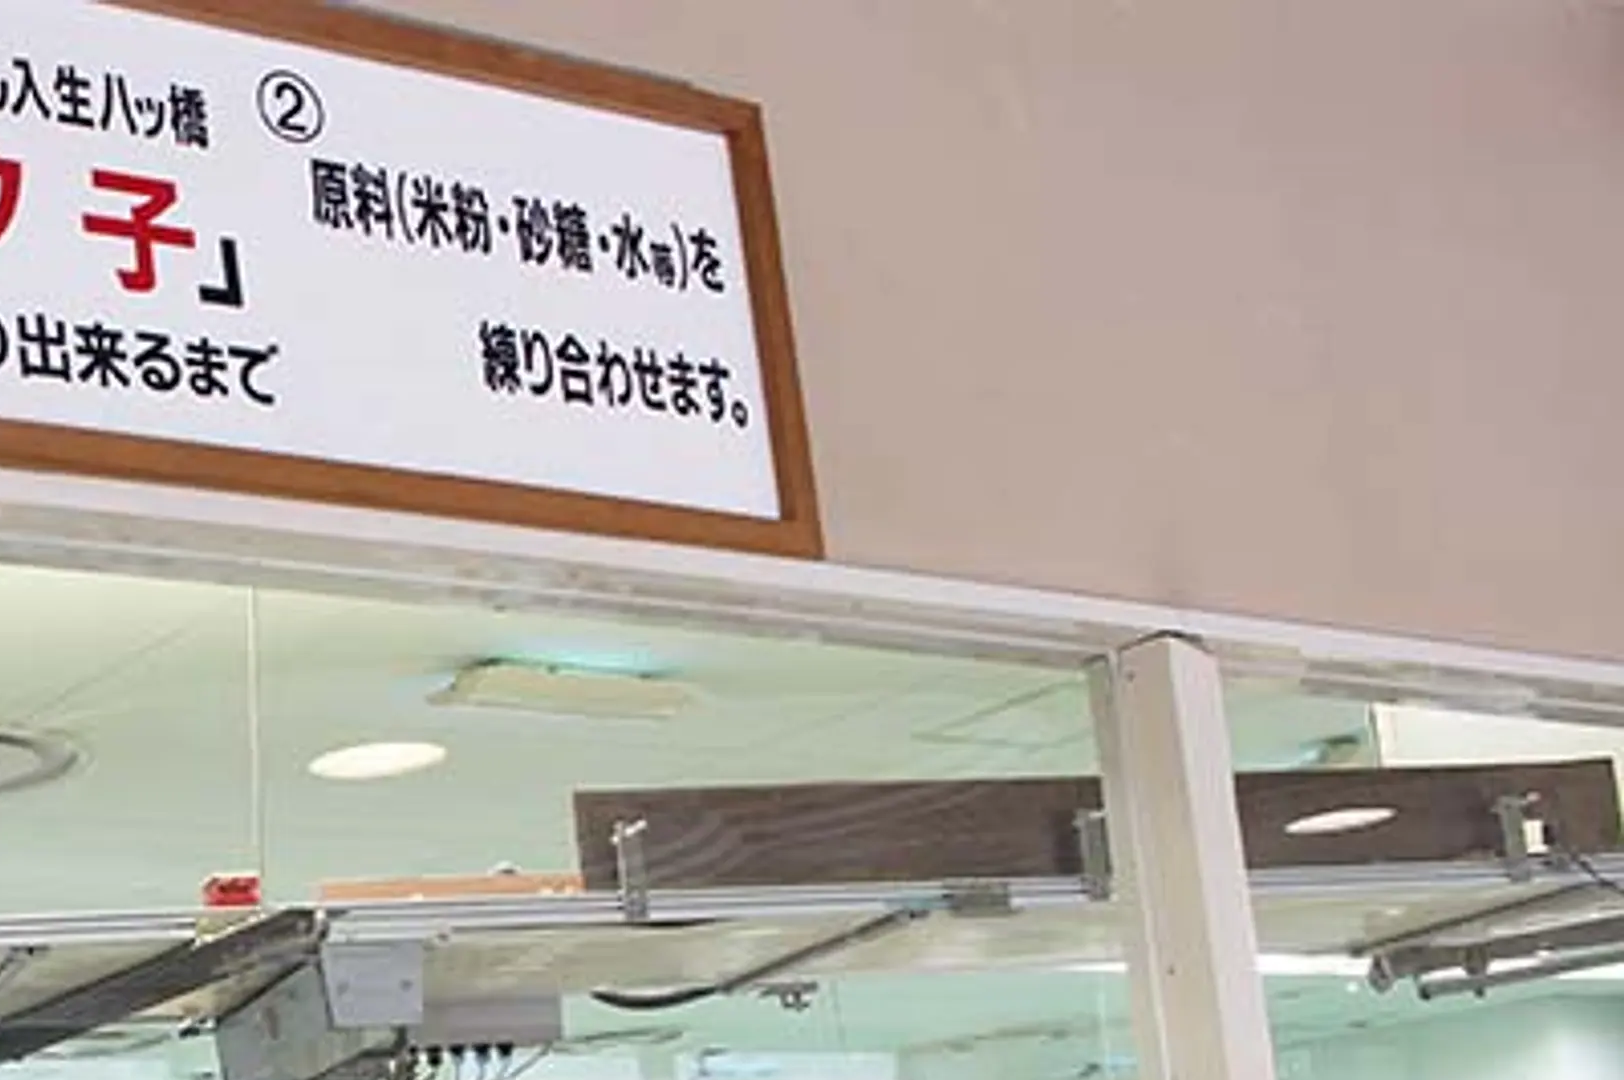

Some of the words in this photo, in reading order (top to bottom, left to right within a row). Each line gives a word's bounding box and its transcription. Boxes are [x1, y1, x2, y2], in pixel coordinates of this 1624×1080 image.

[479, 321, 748, 427] 練り合わせます。
